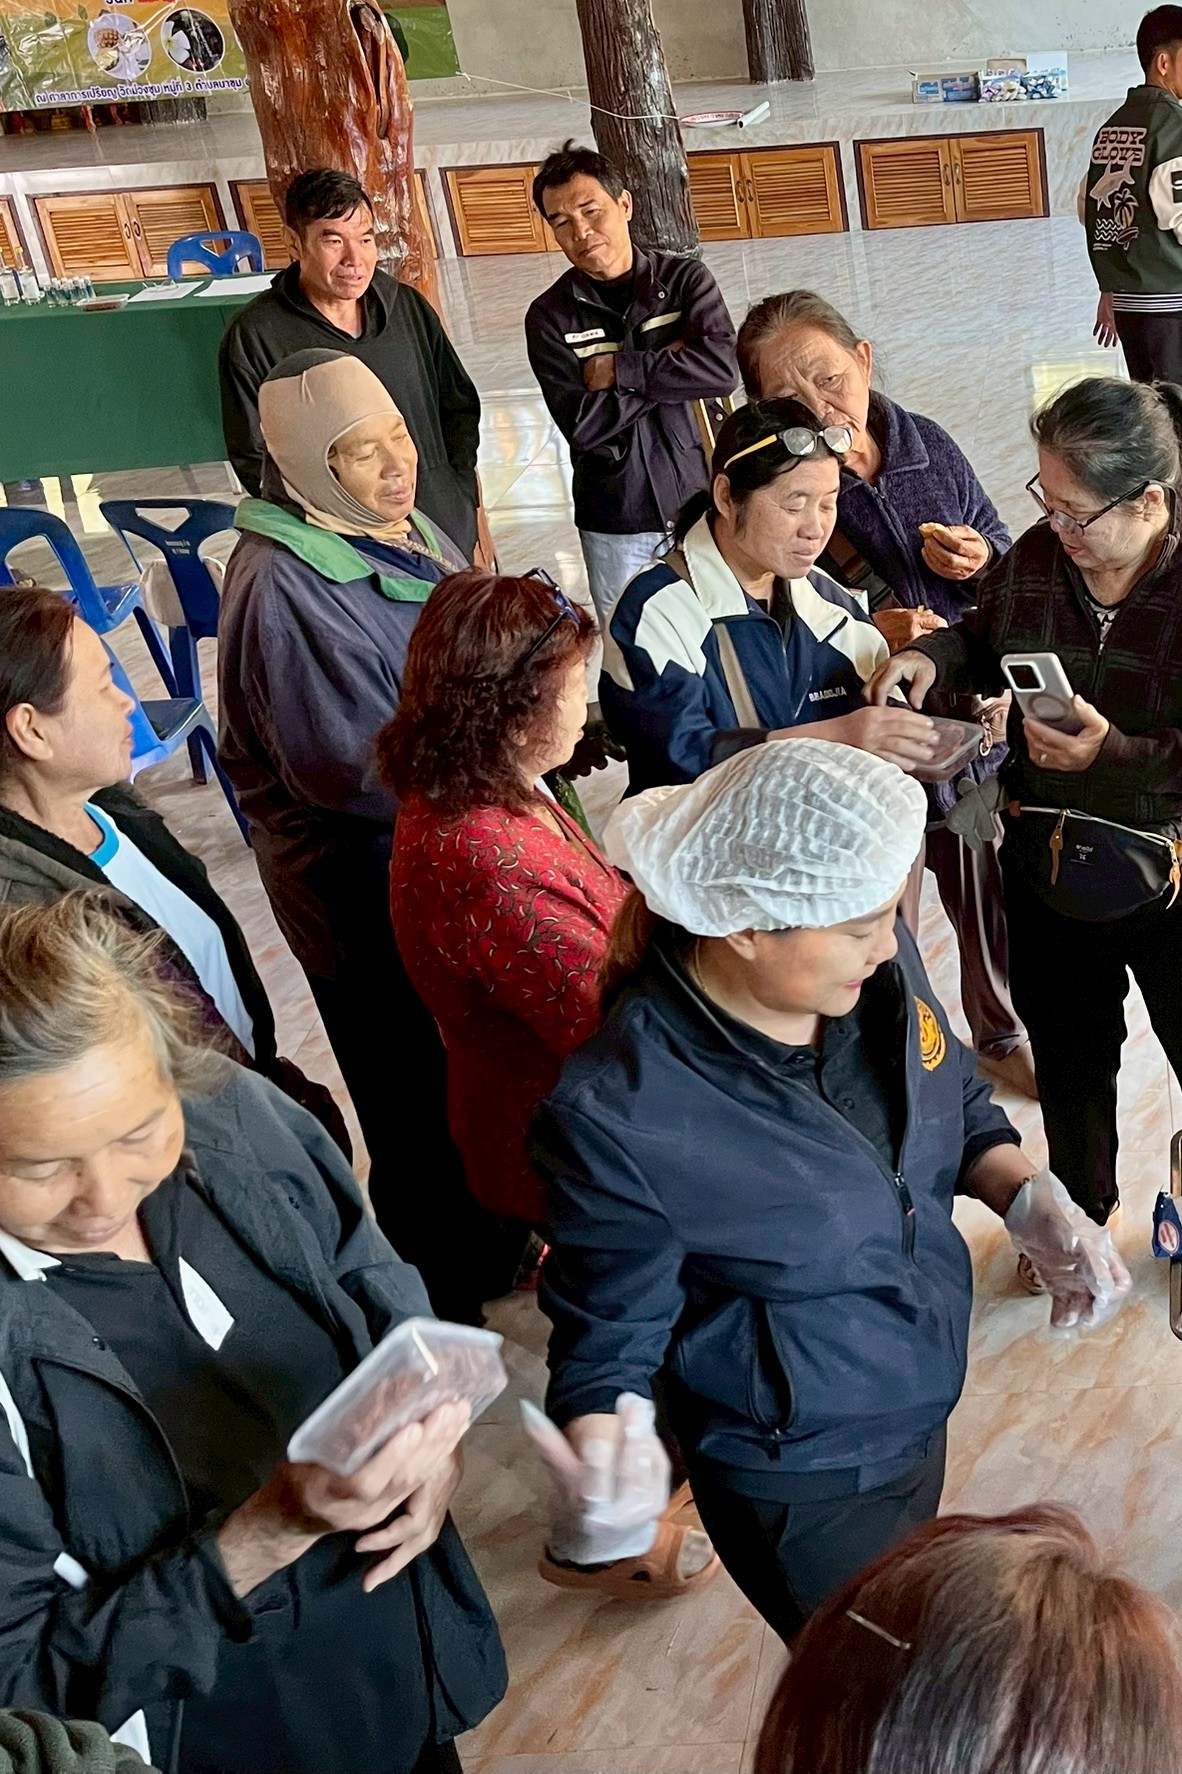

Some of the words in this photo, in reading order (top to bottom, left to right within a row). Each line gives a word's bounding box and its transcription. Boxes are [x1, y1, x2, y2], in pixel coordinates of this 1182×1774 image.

[186, 82, 192, 92] 3
[1099, 131, 1145, 145] BODY
[1092, 147, 1143, 163] GLOVE
